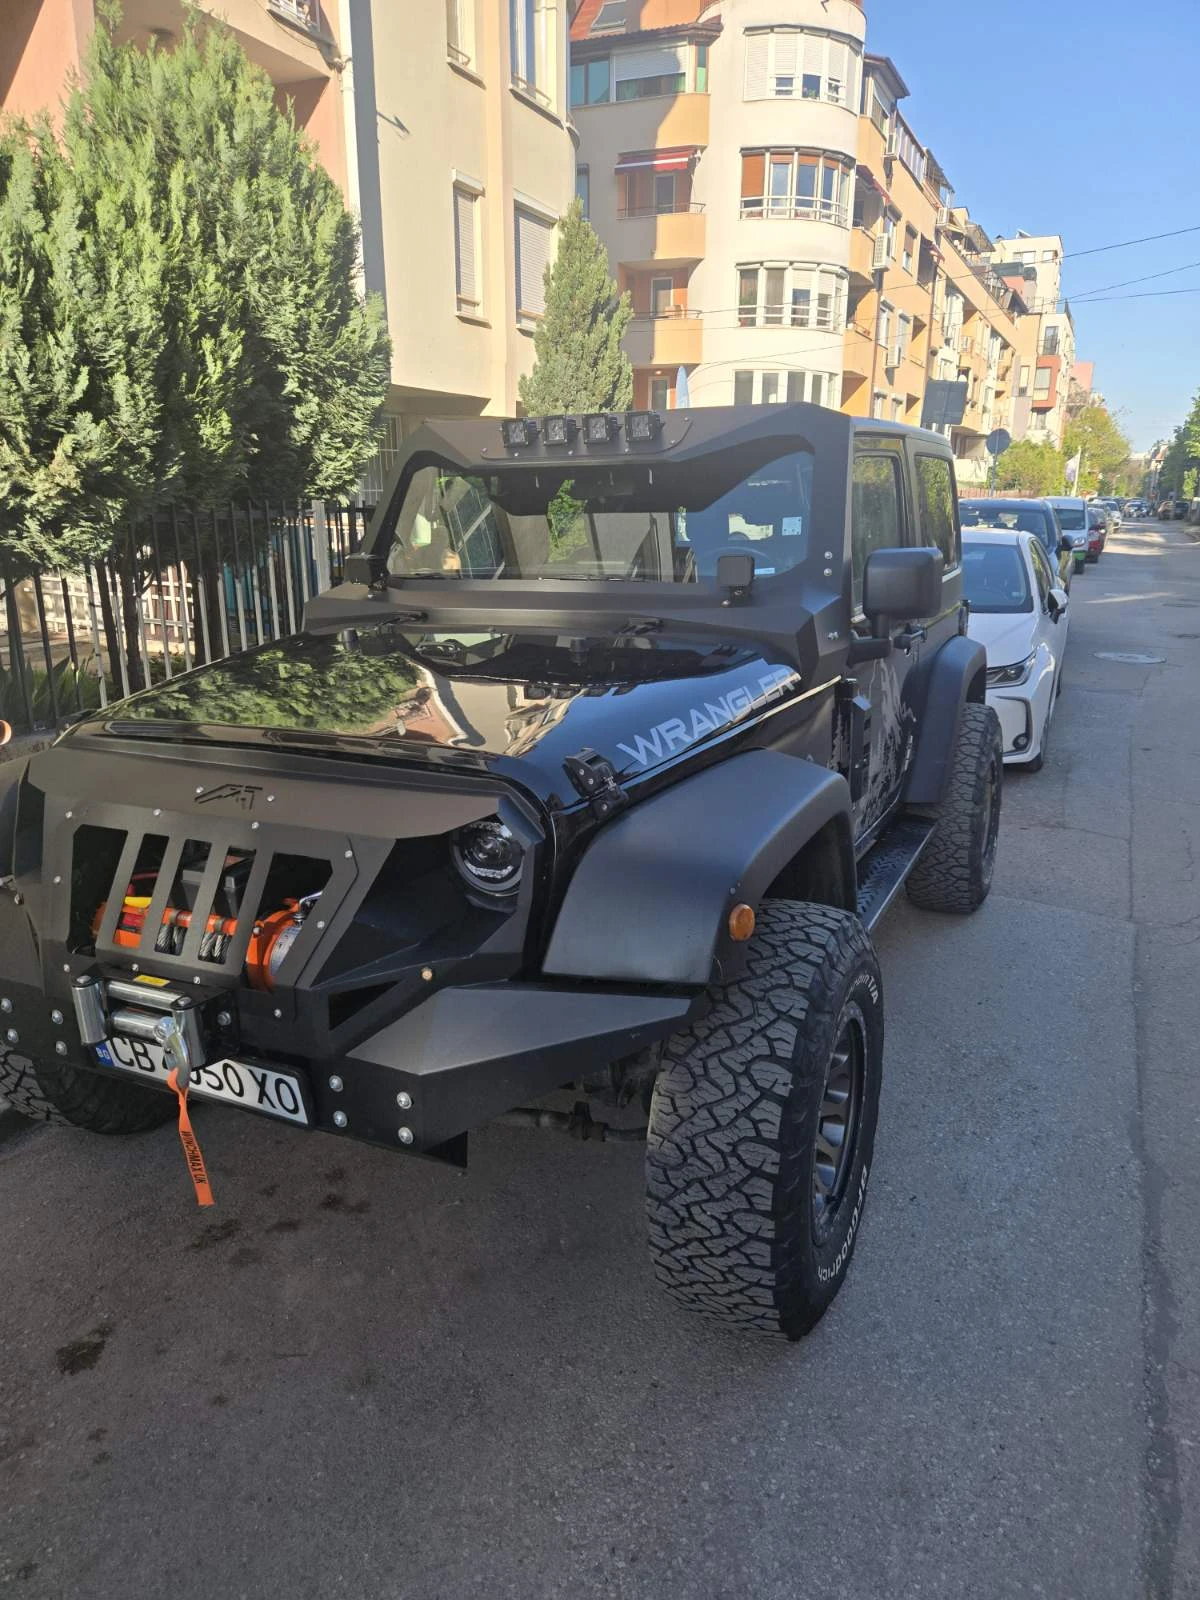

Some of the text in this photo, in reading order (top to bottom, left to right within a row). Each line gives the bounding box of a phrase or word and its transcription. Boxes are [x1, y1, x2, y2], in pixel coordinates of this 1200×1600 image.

[616, 668, 796, 766] WRANGLER
[110, 1036, 156, 1073] CB
[248, 1068, 300, 1115] XO
